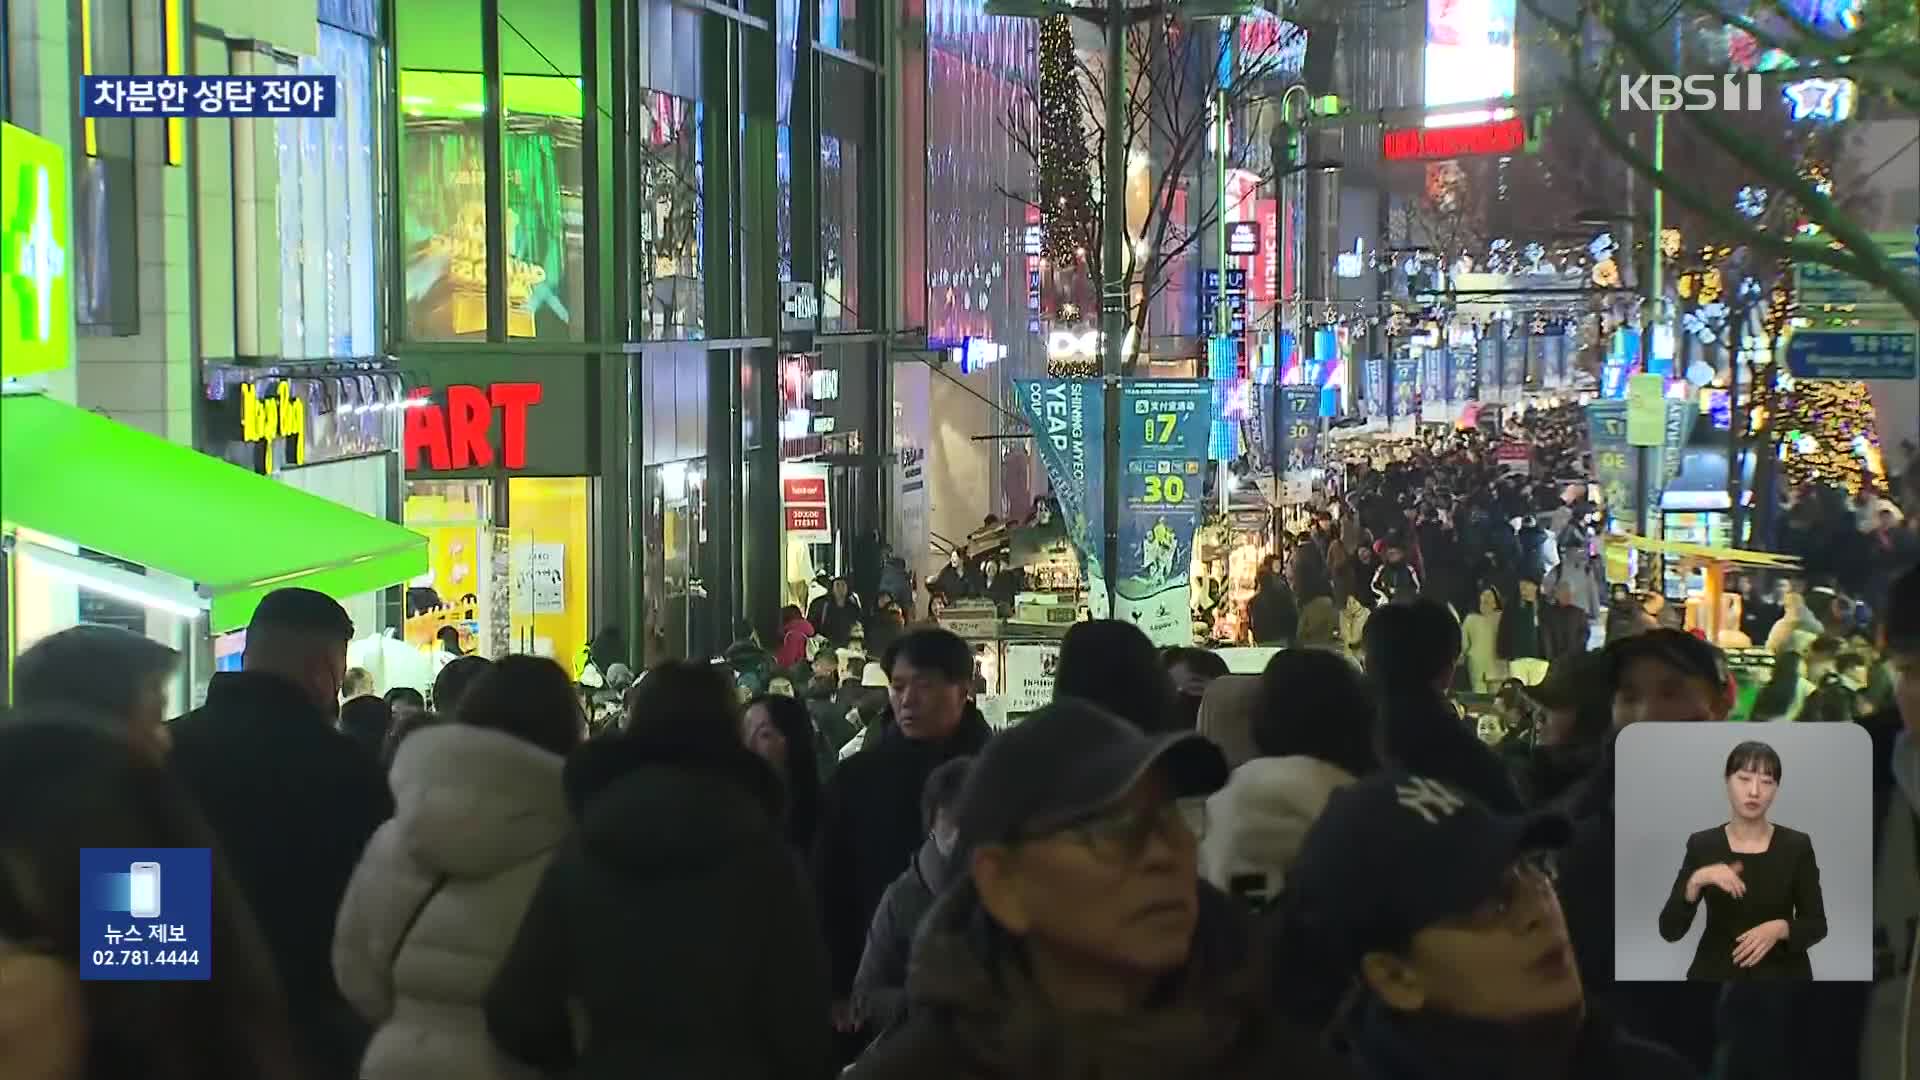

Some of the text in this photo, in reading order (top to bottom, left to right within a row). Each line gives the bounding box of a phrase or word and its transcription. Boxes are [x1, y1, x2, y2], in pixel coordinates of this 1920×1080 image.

[404, 382, 542, 472] ART
[1071, 383, 1083, 438] SHINING
[1157, 413, 1177, 443] 7
[1143, 474, 1184, 503] 30
